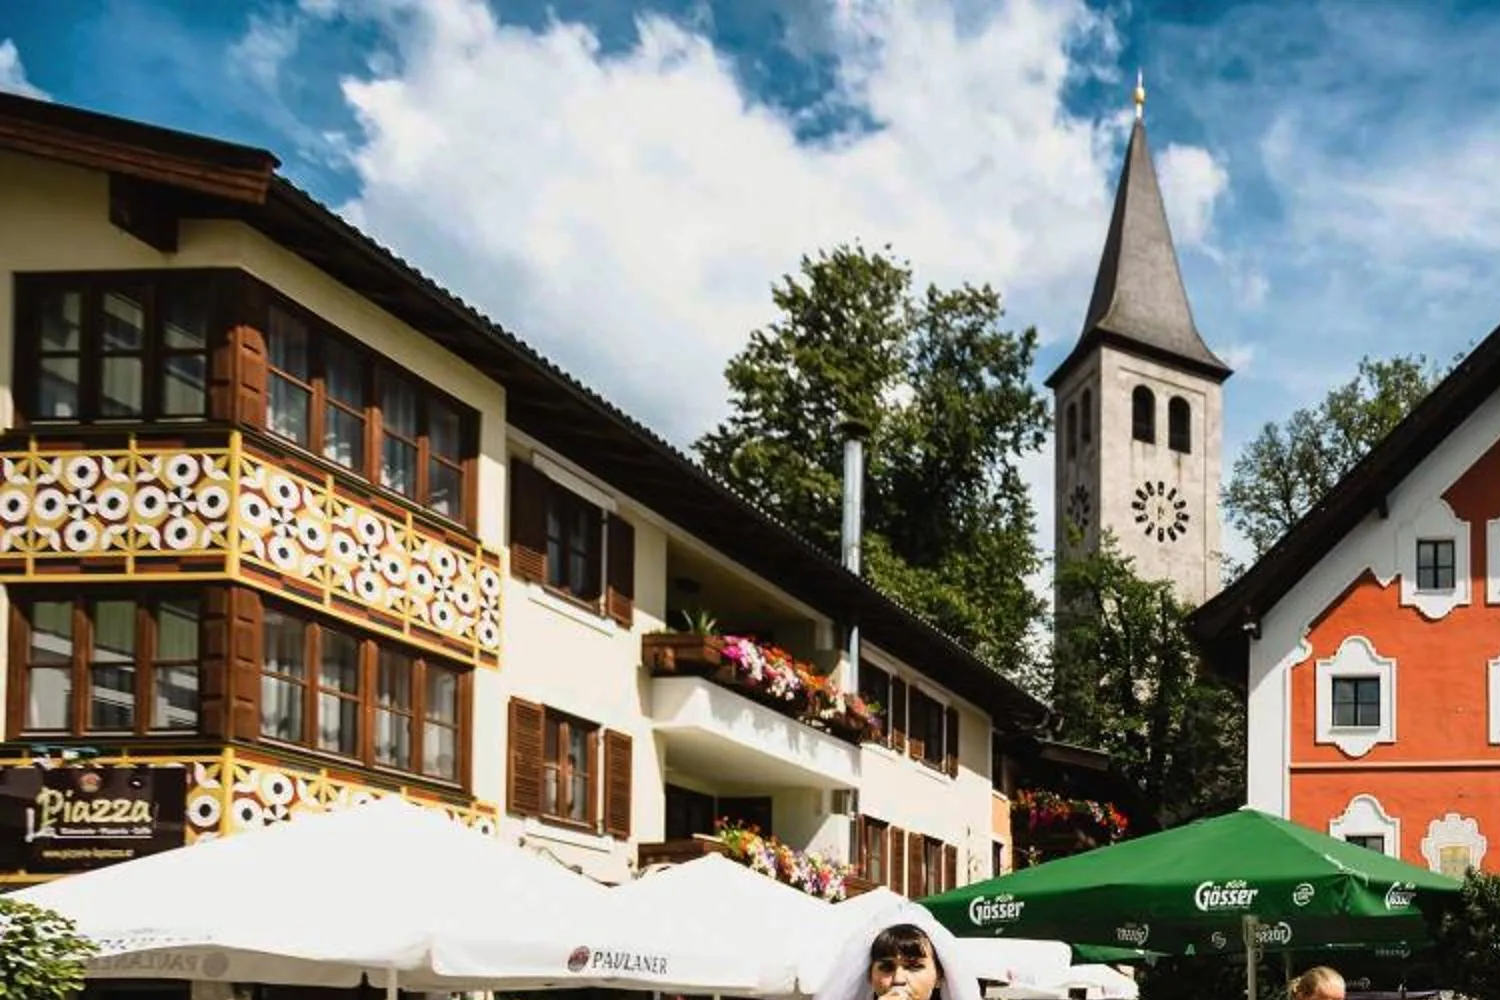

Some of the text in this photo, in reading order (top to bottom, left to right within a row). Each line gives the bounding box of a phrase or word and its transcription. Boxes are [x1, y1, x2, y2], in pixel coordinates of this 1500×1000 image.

[36, 787, 152, 825] Piazza
[969, 895, 1025, 926] Gösser
[1195, 881, 1259, 911] Gösser
[592, 951, 667, 974] PAULANER
